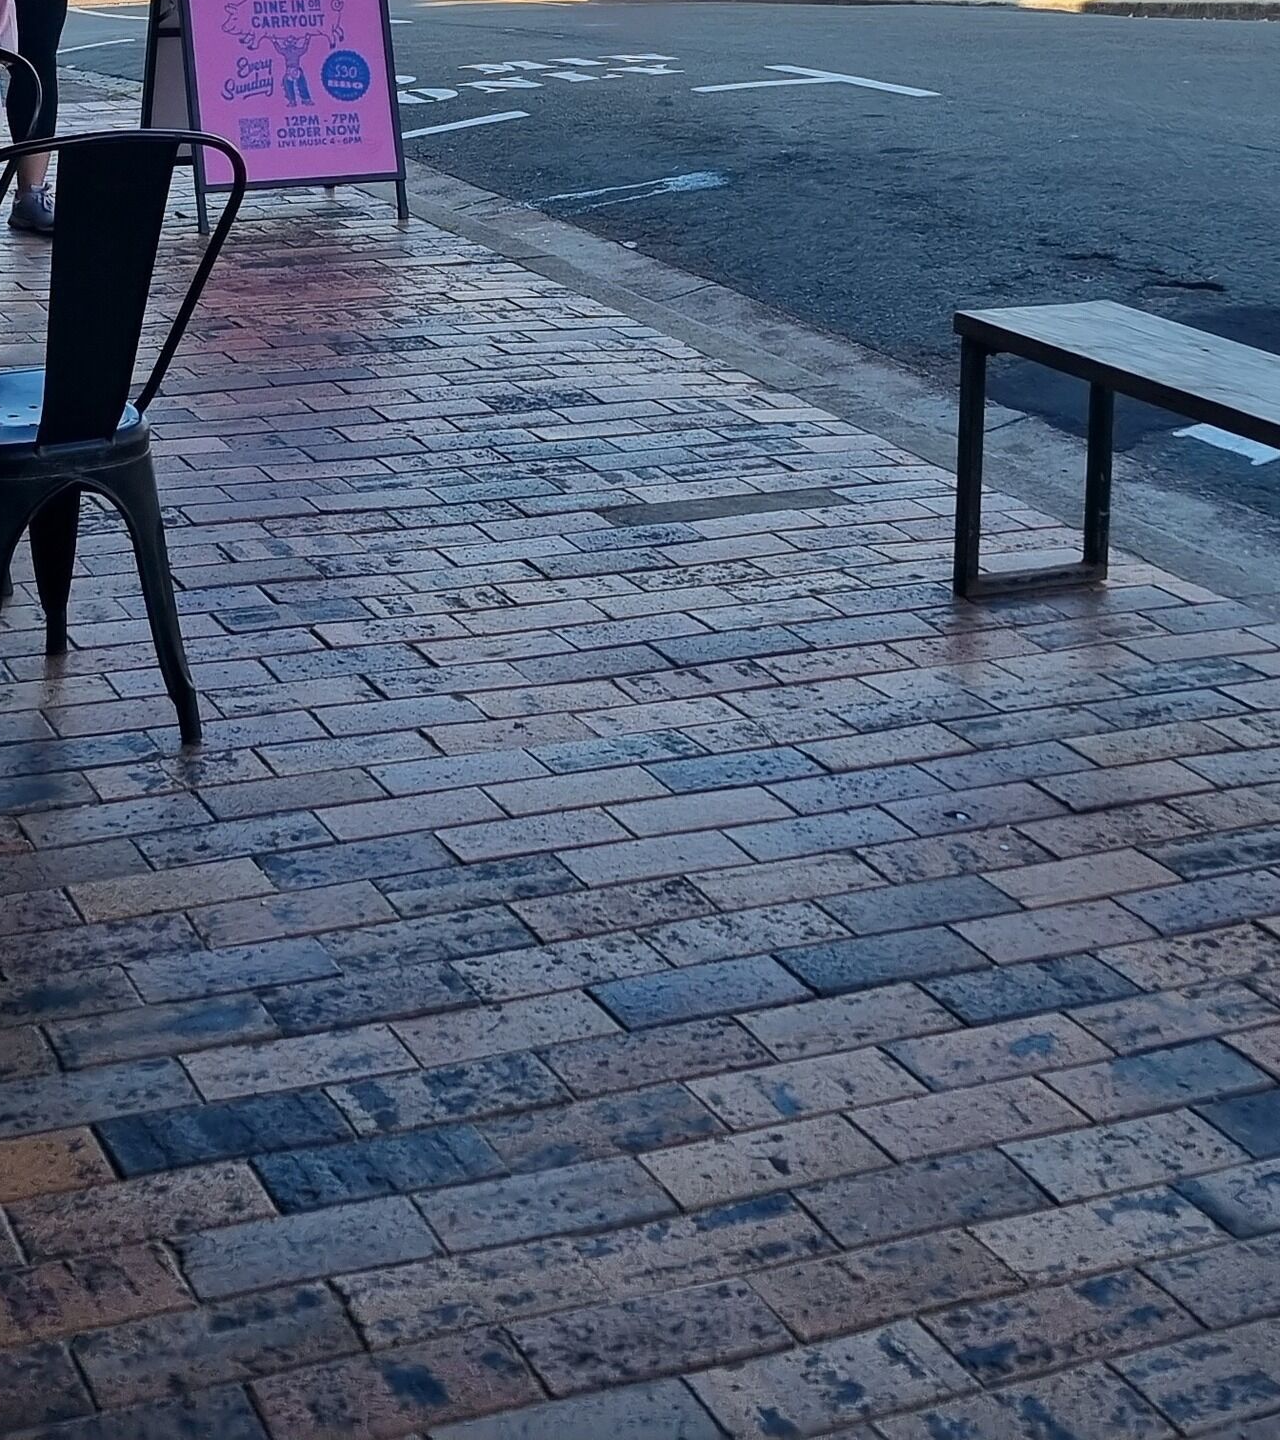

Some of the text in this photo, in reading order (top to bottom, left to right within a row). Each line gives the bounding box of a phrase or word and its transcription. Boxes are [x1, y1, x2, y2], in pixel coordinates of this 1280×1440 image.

[253, 0, 321, 15] DINE IN OR
[251, 14, 325, 29] CARRYOUT
[237, 57, 273, 78] Every
[457, 53, 680, 75] MIN
[221, 73, 273, 101] Sunday
[285, 115, 320, 127] 12PM
[331, 113, 360, 124] 7PM
[276, 124, 361, 139] ORDER NOW
[278, 140, 296, 148] LIVE
[299, 138, 327, 147] MUSIC
